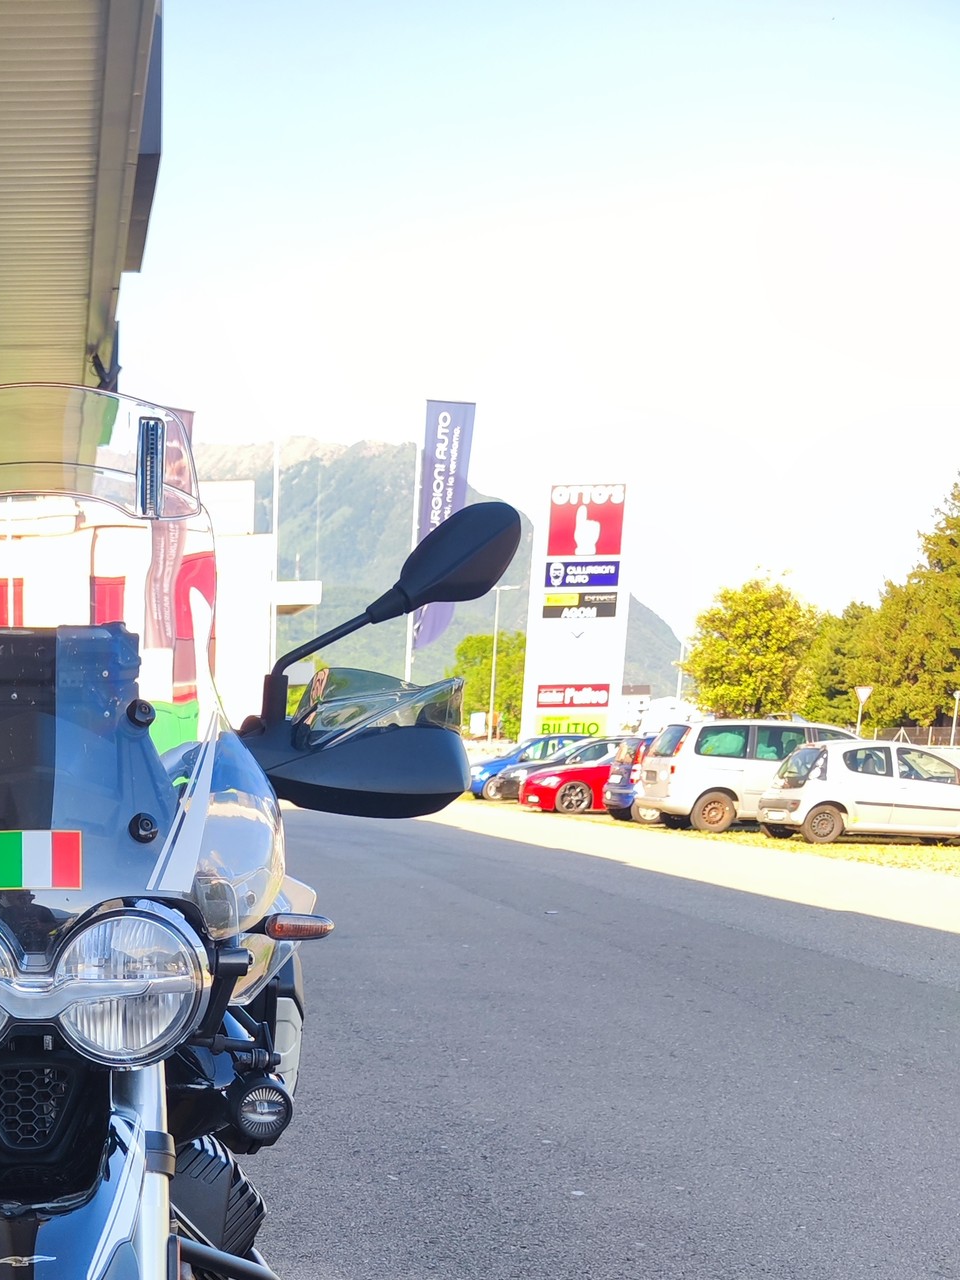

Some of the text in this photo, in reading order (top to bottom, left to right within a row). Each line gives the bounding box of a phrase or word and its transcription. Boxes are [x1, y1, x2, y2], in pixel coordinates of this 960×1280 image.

[430, 411, 451, 532] URGIONI AUTO
[552, 485, 625, 505] OTTO'S
[565, 574, 589, 584] AUTO
